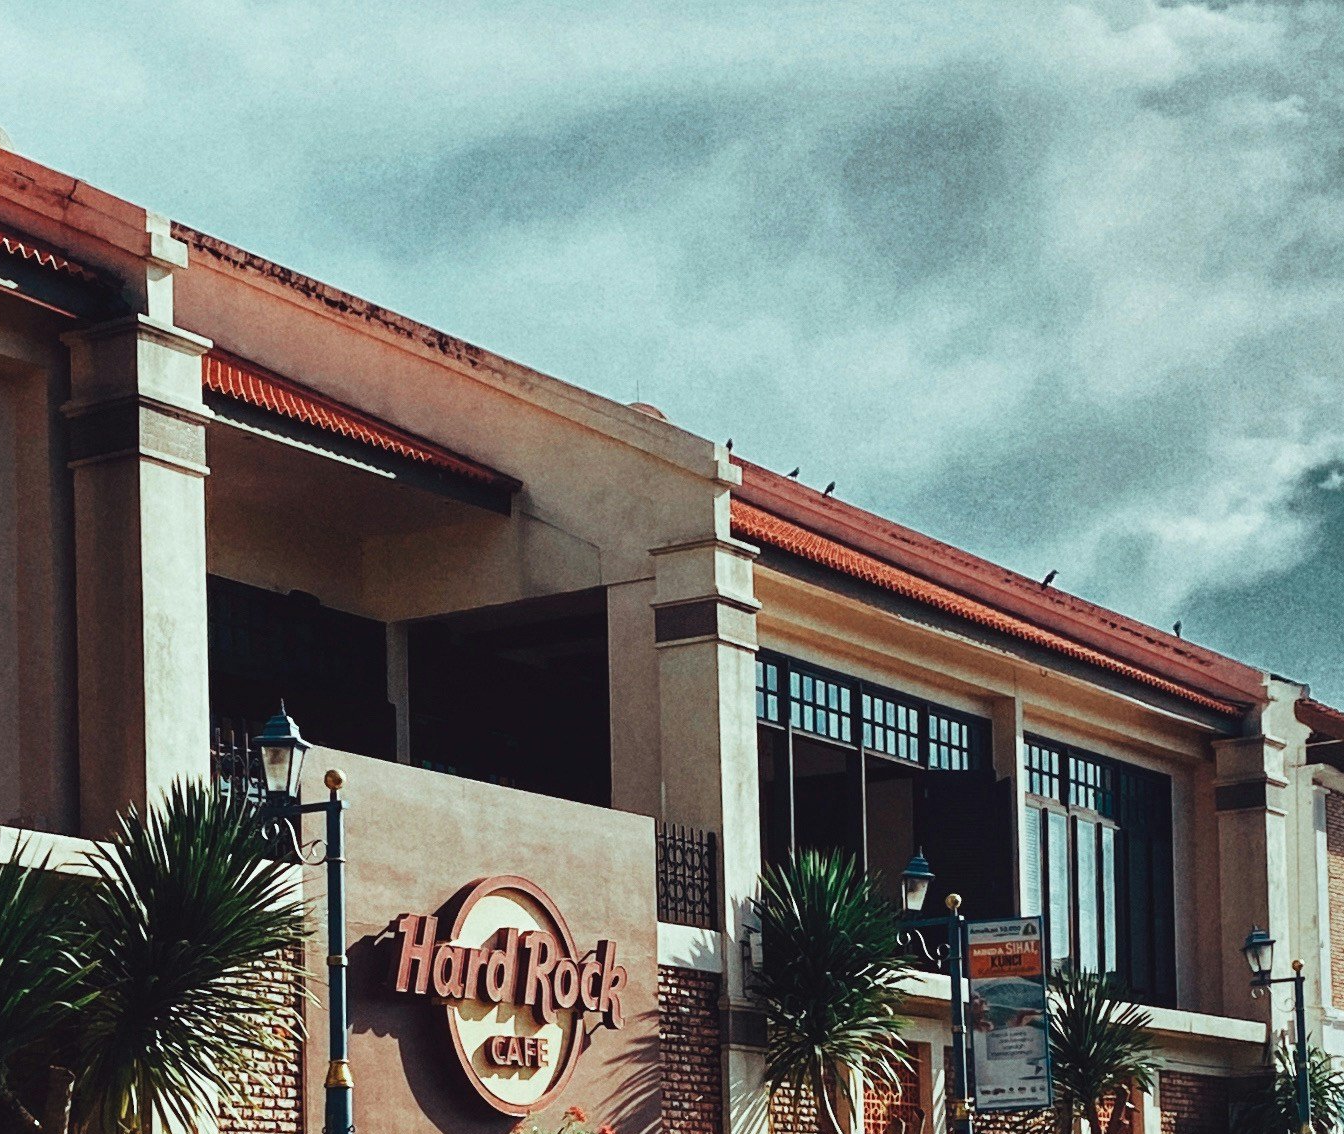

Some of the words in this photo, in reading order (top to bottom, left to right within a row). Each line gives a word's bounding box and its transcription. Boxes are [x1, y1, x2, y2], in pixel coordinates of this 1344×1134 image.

[396, 913, 519, 1003] Hard
[524, 930, 628, 1030] Rock
[491, 1035, 549, 1068] CAFE
